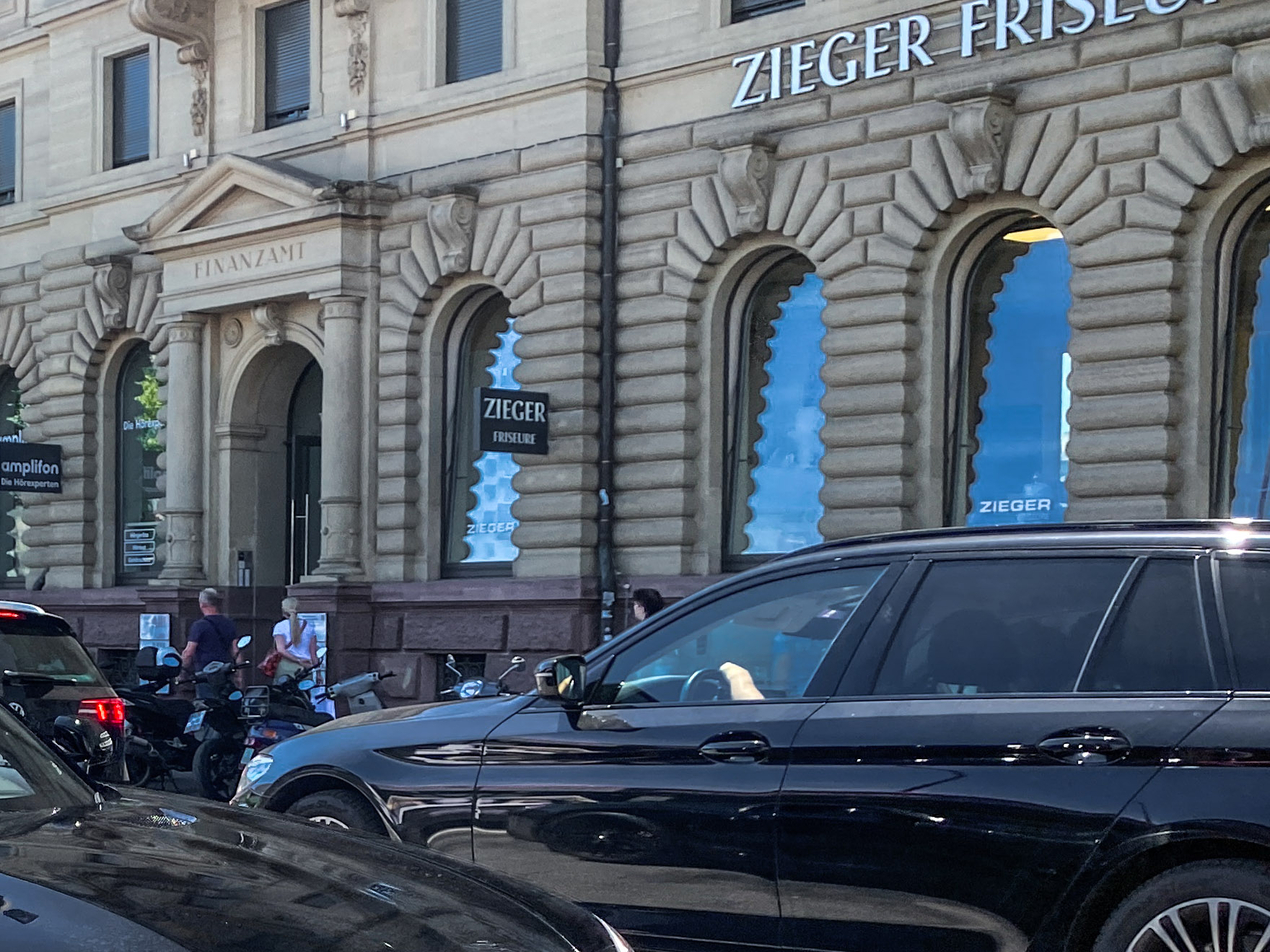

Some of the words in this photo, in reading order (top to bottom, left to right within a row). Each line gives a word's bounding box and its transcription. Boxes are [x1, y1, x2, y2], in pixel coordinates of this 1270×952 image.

[731, 13, 934, 108] ZIEGER
[195, 241, 307, 279] FINANZAMT
[484, 398, 546, 423] ZIEGER
[124, 420, 134, 431] Die
[493, 431, 537, 445] FRISEURE
[1, 459, 59, 477] amplifon
[1, 478, 13, 486] Die
[14, 478, 59, 489] Hörexperten
[980, 499, 1051, 513] ZIEGER
[467, 521, 515, 534] ZIEGER
